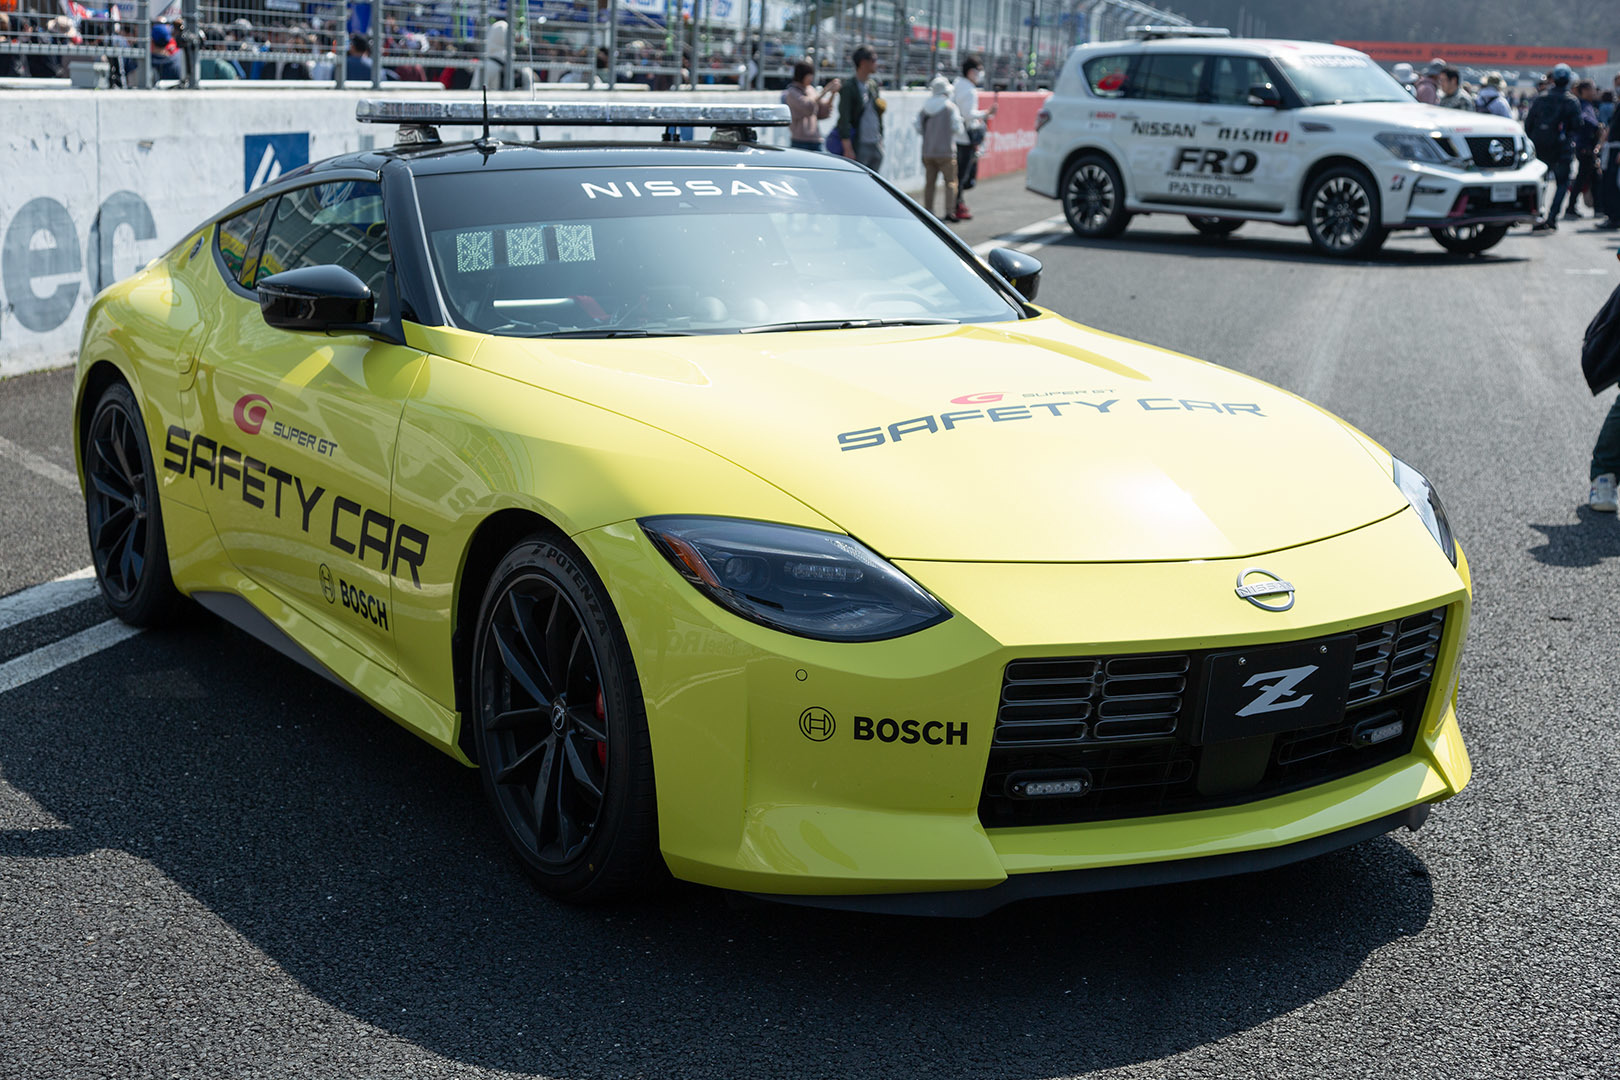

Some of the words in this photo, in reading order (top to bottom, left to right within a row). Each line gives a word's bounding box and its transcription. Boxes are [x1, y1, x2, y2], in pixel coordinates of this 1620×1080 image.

[1131, 121, 1196, 138] NISSAN
[1171, 147, 1258, 175] FRO
[581, 180, 799, 199] NISSAN
[1169, 181, 1236, 198] PATROL
[0, 192, 157, 334] ec
[273, 421, 317, 450] SUPER
[317, 439, 338, 457] GT
[837, 399, 1120, 451] SAFETY
[1136, 397, 1268, 417] CAR
[163, 424, 326, 532] SAFETY
[330, 495, 430, 589] CAR
[339, 578, 389, 631] BOSCH
[546, 547, 608, 636] POTENZA
[854, 716, 968, 745] BOSCH
